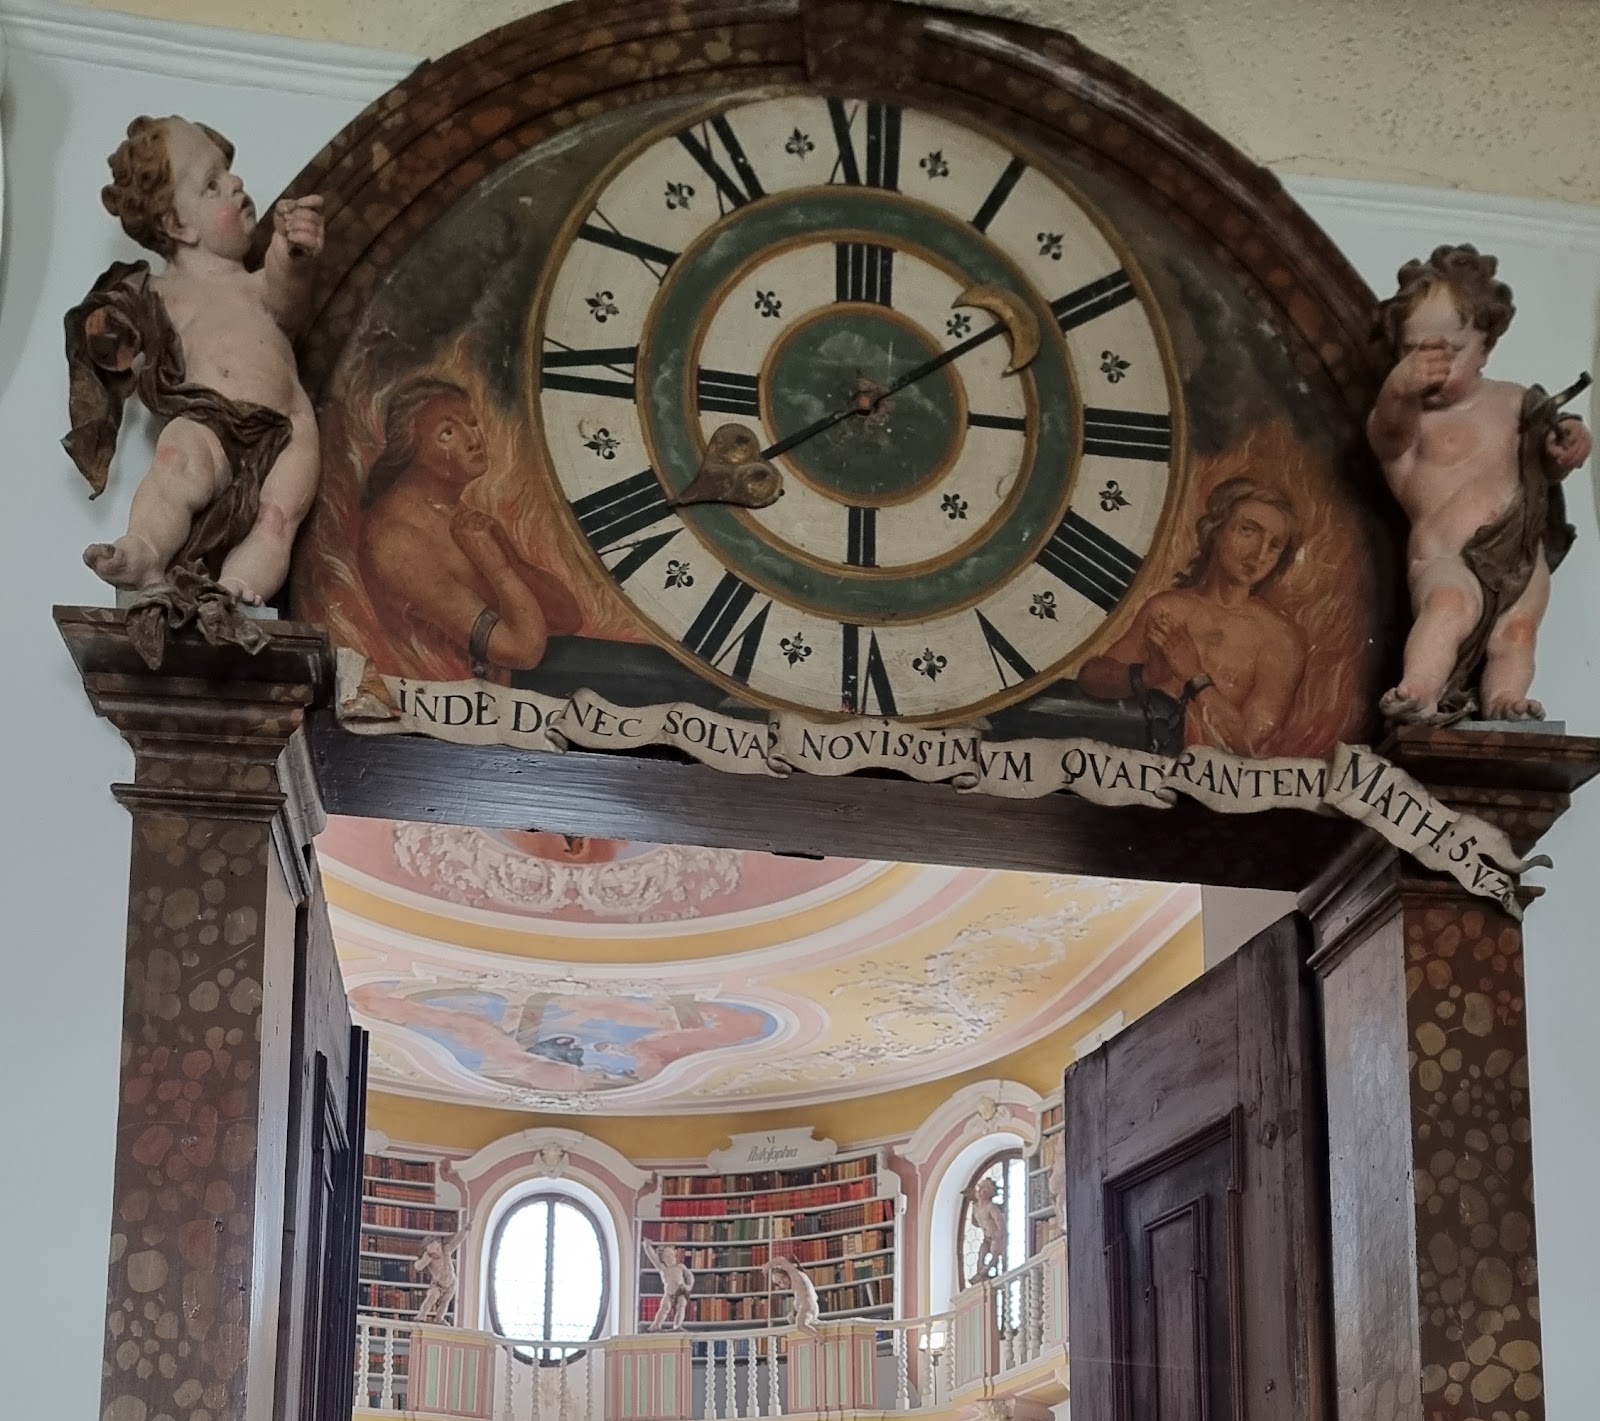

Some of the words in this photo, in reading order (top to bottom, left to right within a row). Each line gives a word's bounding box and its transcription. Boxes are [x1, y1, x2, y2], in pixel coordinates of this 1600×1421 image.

[676, 113, 770, 217] XI
[825, 97, 903, 194] XII
[968, 157, 1026, 234] I
[578, 208, 684, 287] X
[833, 242, 896, 310] IIII
[1050, 268, 1138, 338] II
[540, 337, 640, 405] IX
[697, 365, 761, 420] III
[1082, 405, 1171, 468] III
[680, 568, 773, 687] VII
[974, 607, 1040, 691] V
[400, 679, 499, 726] INDE
[661, 710, 781, 759] SOLVAS
